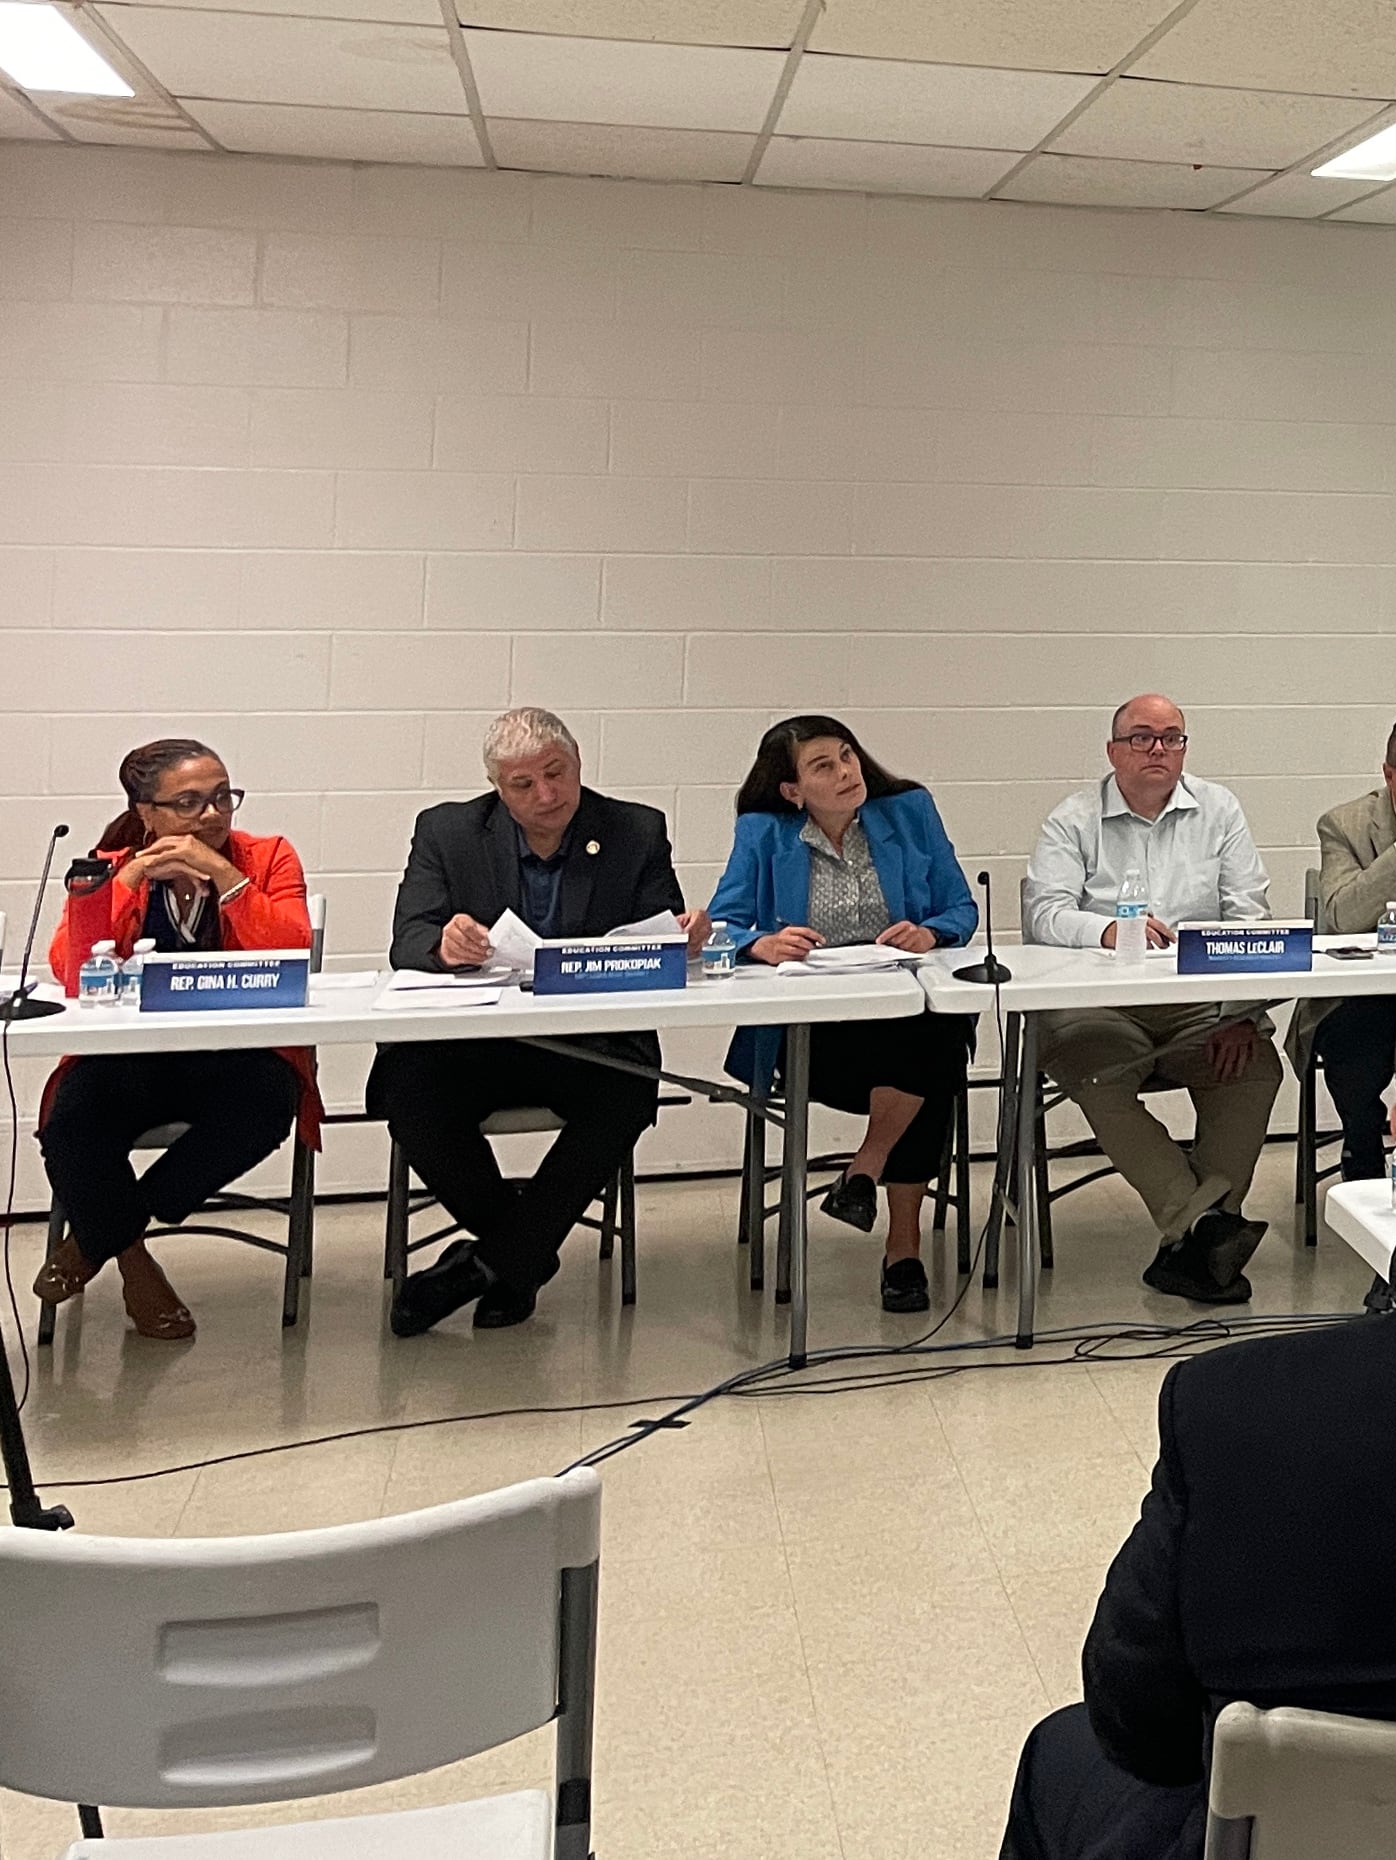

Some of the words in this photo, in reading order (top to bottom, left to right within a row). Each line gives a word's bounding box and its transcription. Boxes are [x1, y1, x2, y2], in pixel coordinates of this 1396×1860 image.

[1206, 941, 1246, 955] THOMAS
[561, 960, 583, 974] REP.
[585, 959, 603, 973] JIM
[604, 957, 662, 972] PROKOPIAK
[170, 975, 194, 992] REP.
[197, 974, 225, 991] GINA
[226, 974, 239, 990] H.
[241, 972, 281, 990] CURRY
